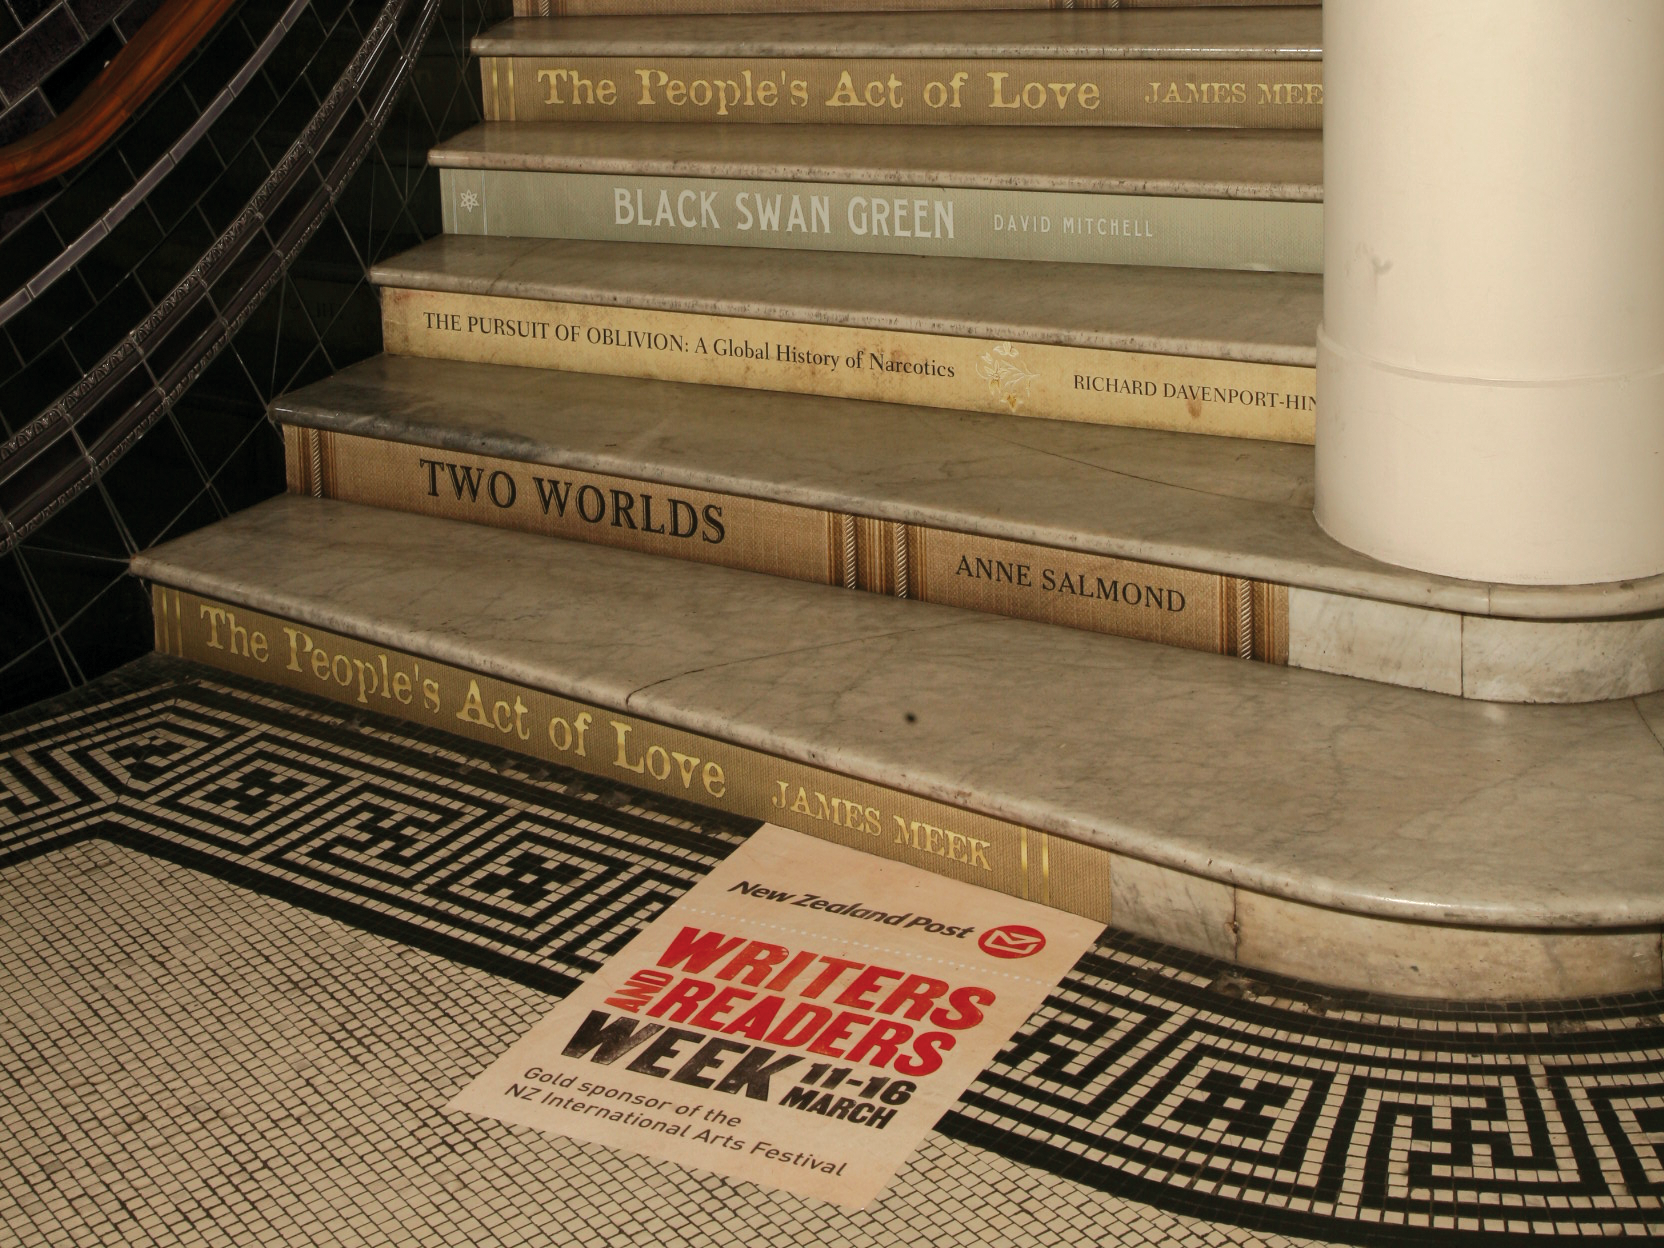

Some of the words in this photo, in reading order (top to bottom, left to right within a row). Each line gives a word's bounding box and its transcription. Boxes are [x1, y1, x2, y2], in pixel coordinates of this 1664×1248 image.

[537, 69, 617, 105] The
[635, 69, 809, 115] People's
[825, 70, 904, 108] Act
[923, 71, 968, 108] of
[987, 72, 1101, 110] Love
[1144, 81, 1248, 105] JAMES
[1257, 83, 1323, 105] MEE
[614, 188, 720, 229] BLACK
[735, 191, 831, 234] SWAN
[847, 196, 955, 239] GREEN
[994, 214, 1051, 233] DAVID
[1063, 216, 1153, 237] MITCHELL
[423, 311, 462, 332] THE
[467, 315, 549, 340] PURSUIT
[555, 323, 581, 342] OF
[586, 326, 689, 353] OBLIVION:
[694, 337, 708, 354] A
[713, 338, 770, 360] Global
[776, 344, 840, 372] History
[845, 349, 865, 369] of
[869, 351, 956, 378] Narcotics
[1073, 374, 1158, 398] RICHARD
[1163, 382, 1316, 411] DAVENPORT-HIN
[419, 458, 517, 509] TWO
[532, 476, 725, 544] WORLDS
[956, 555, 1031, 586] ANNE
[1042, 568, 1186, 613] SALMOND
[200, 603, 269, 663] The
[283, 626, 441, 714] People's
[456, 679, 531, 741] Act
[548, 711, 593, 757] of
[610, 720, 726, 798] Love
[771, 780, 882, 837] JAMES
[893, 814, 992, 871] MEEK
[728, 880, 790, 904] New
[604, 969, 674, 1014] AND
[656, 926, 996, 1030] WRITERS
[560, 1009, 806, 1101] WEEK
[799, 1062, 917, 1105] 11-16
[646, 977, 956, 1077] READERS
[504, 1082, 537, 1102] NZ
[540, 1090, 690, 1139] International
[692, 1126, 745, 1153] Arts
[750, 1141, 848, 1177] Festival
[523, 1067, 577, 1090] Gold
[578, 1080, 672, 1111] sponsor
[675, 1099, 705, 1118] of
[711, 1105, 742, 1129] the
[778, 1086, 897, 1130] MARCH
